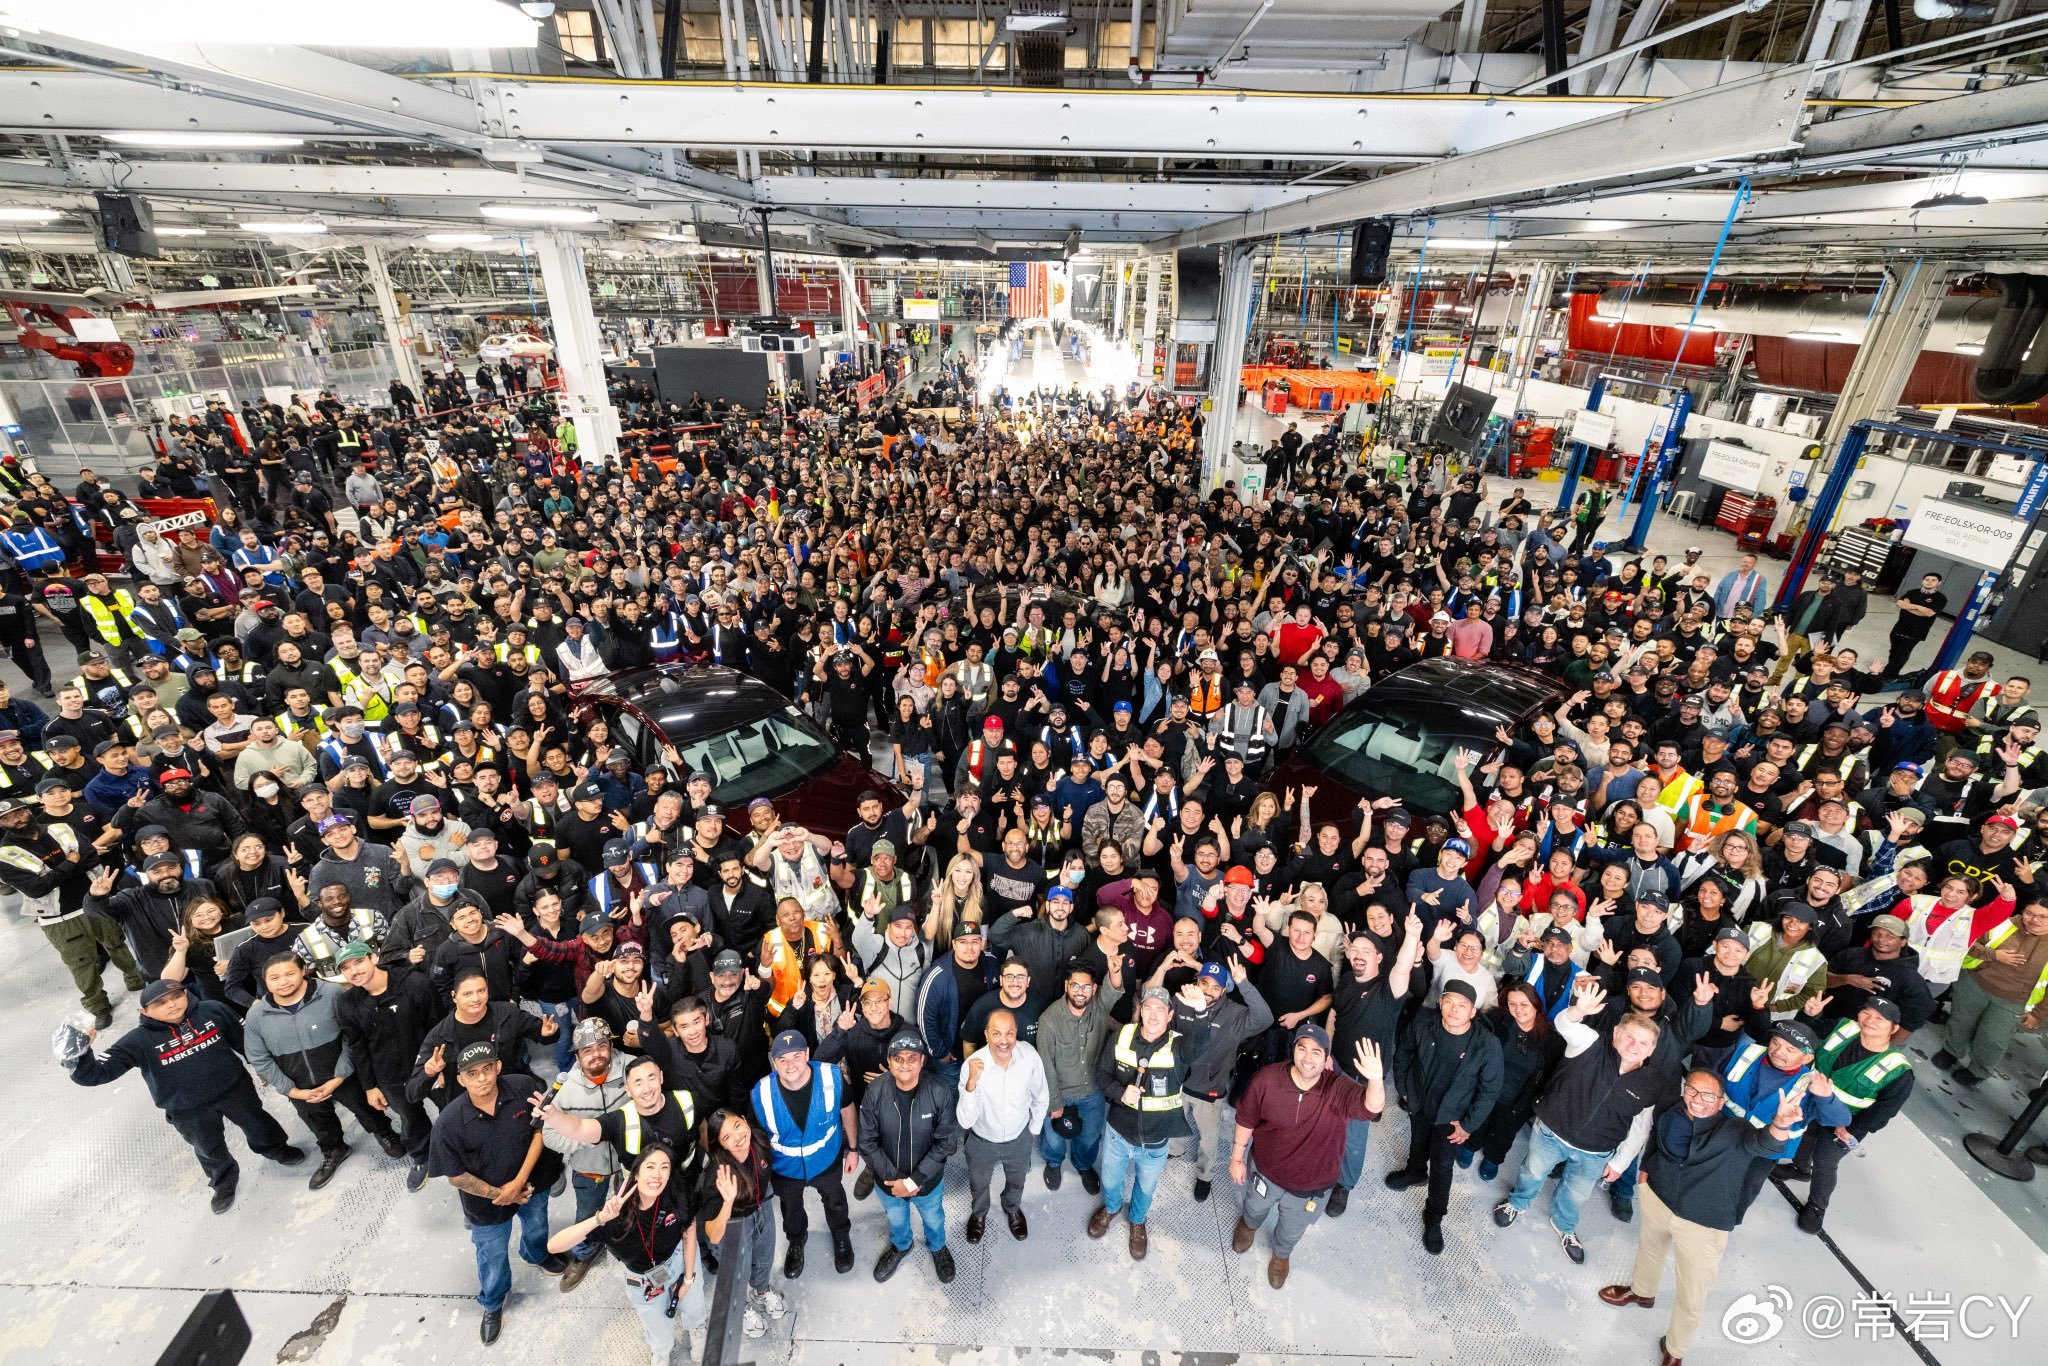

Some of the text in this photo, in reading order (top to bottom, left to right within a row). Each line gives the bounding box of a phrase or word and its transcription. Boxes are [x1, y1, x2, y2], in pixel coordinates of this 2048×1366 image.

[1671, 395, 1686, 429] ROTARY LIFT
[2018, 464, 2048, 516] ROTARY LIFT
[1924, 510, 2013, 540] FRE-EOLSX-OR-009
[1861, 569, 1878, 580] HD
[963, 924, 972, 934] LA
[1208, 964, 1220, 974] D
[155, 1020, 215, 1053] TESLA
[160, 1034, 221, 1066] BASKETBALL
[462, 1045, 491, 1061] TOWN
